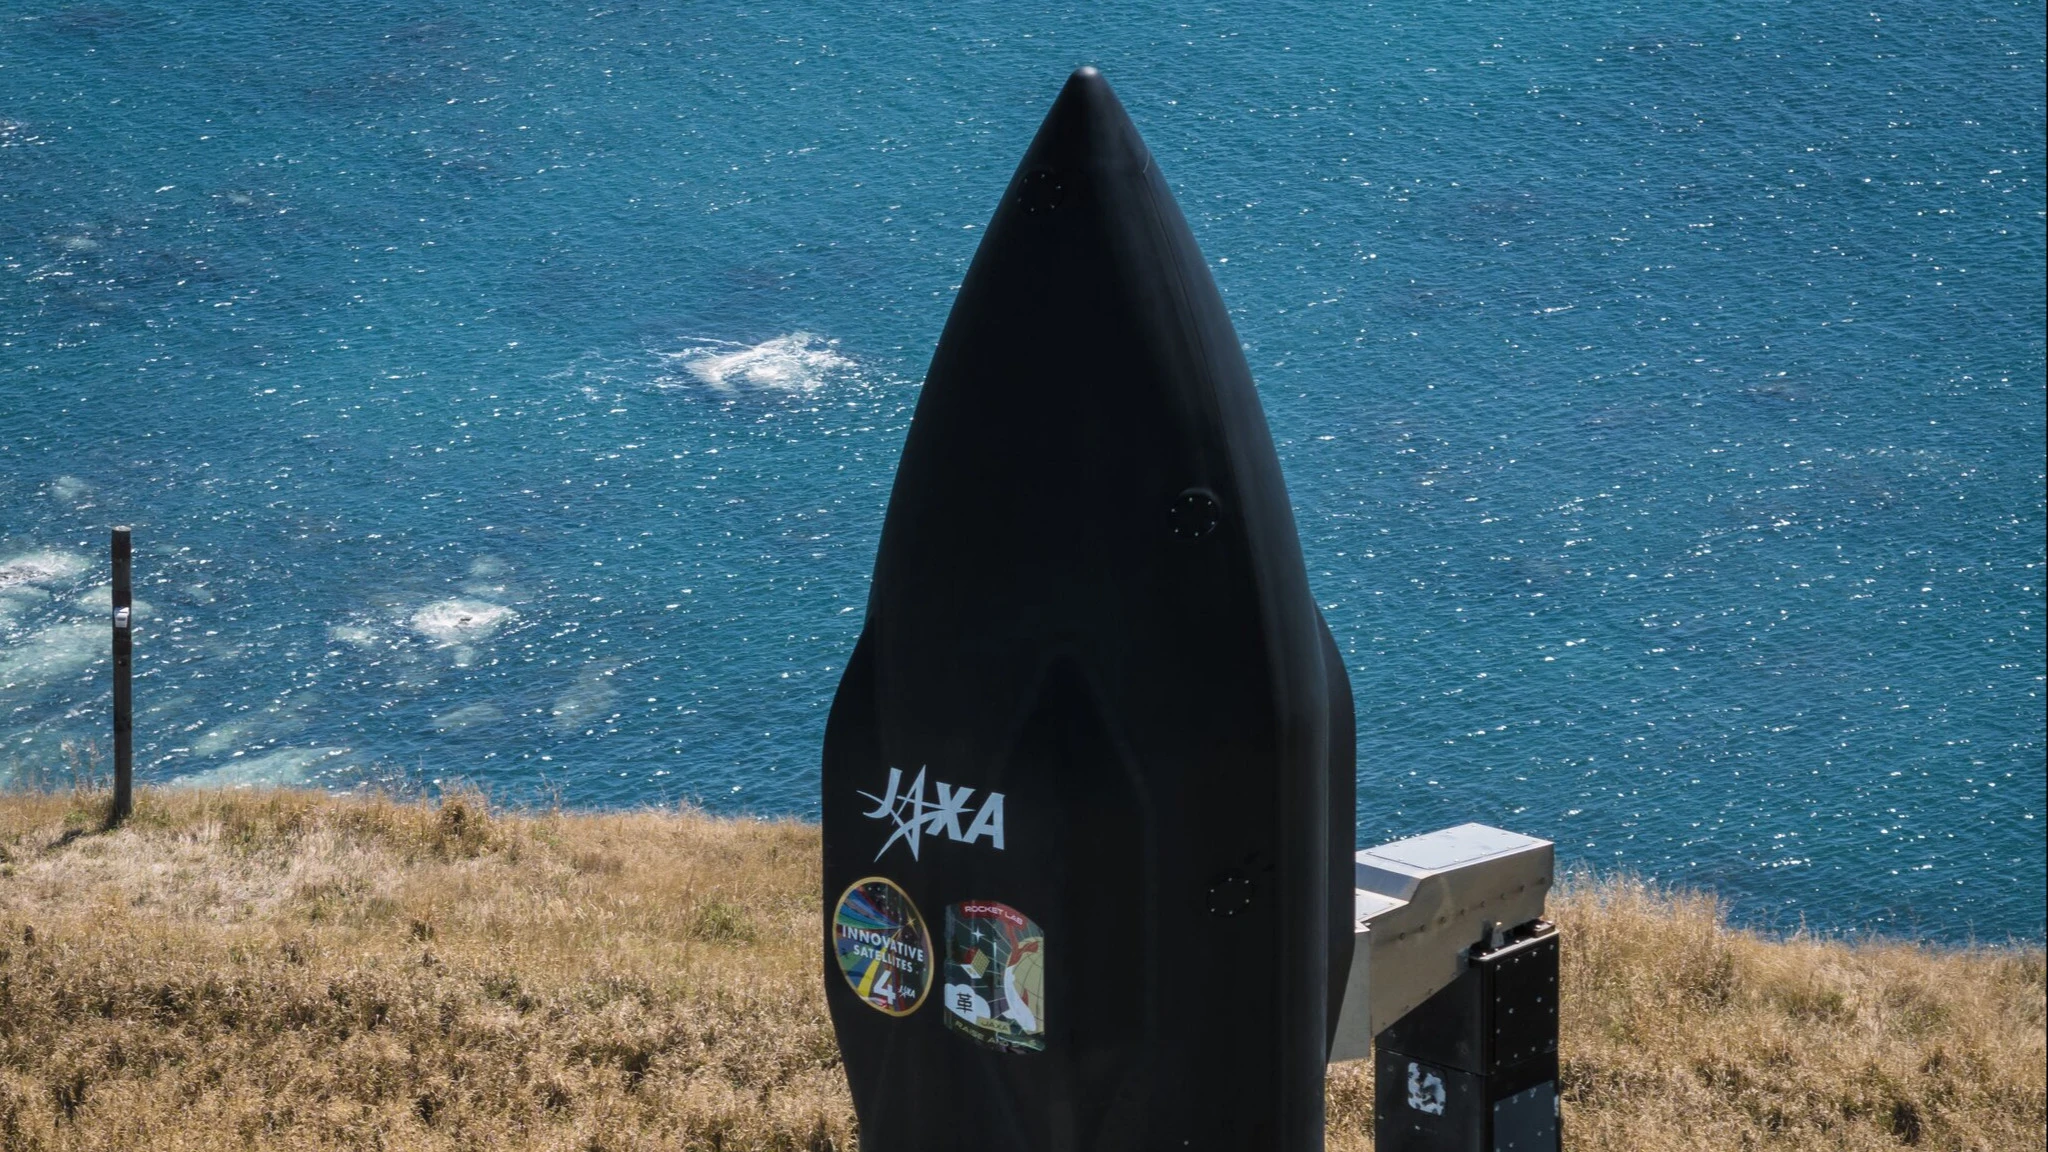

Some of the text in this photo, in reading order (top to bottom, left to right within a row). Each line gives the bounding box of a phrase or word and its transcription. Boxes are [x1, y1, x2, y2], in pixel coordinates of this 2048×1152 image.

[857, 764, 1006, 862] JAXA
[964, 905, 1023, 926] ROCKET LAB
[842, 925, 924, 962] INNOVATIVE
[853, 944, 913, 973] SATELLITES
[873, 970, 896, 1005] 4
[899, 985, 916, 998] JAXA
[980, 1020, 1010, 1032] JAXA
